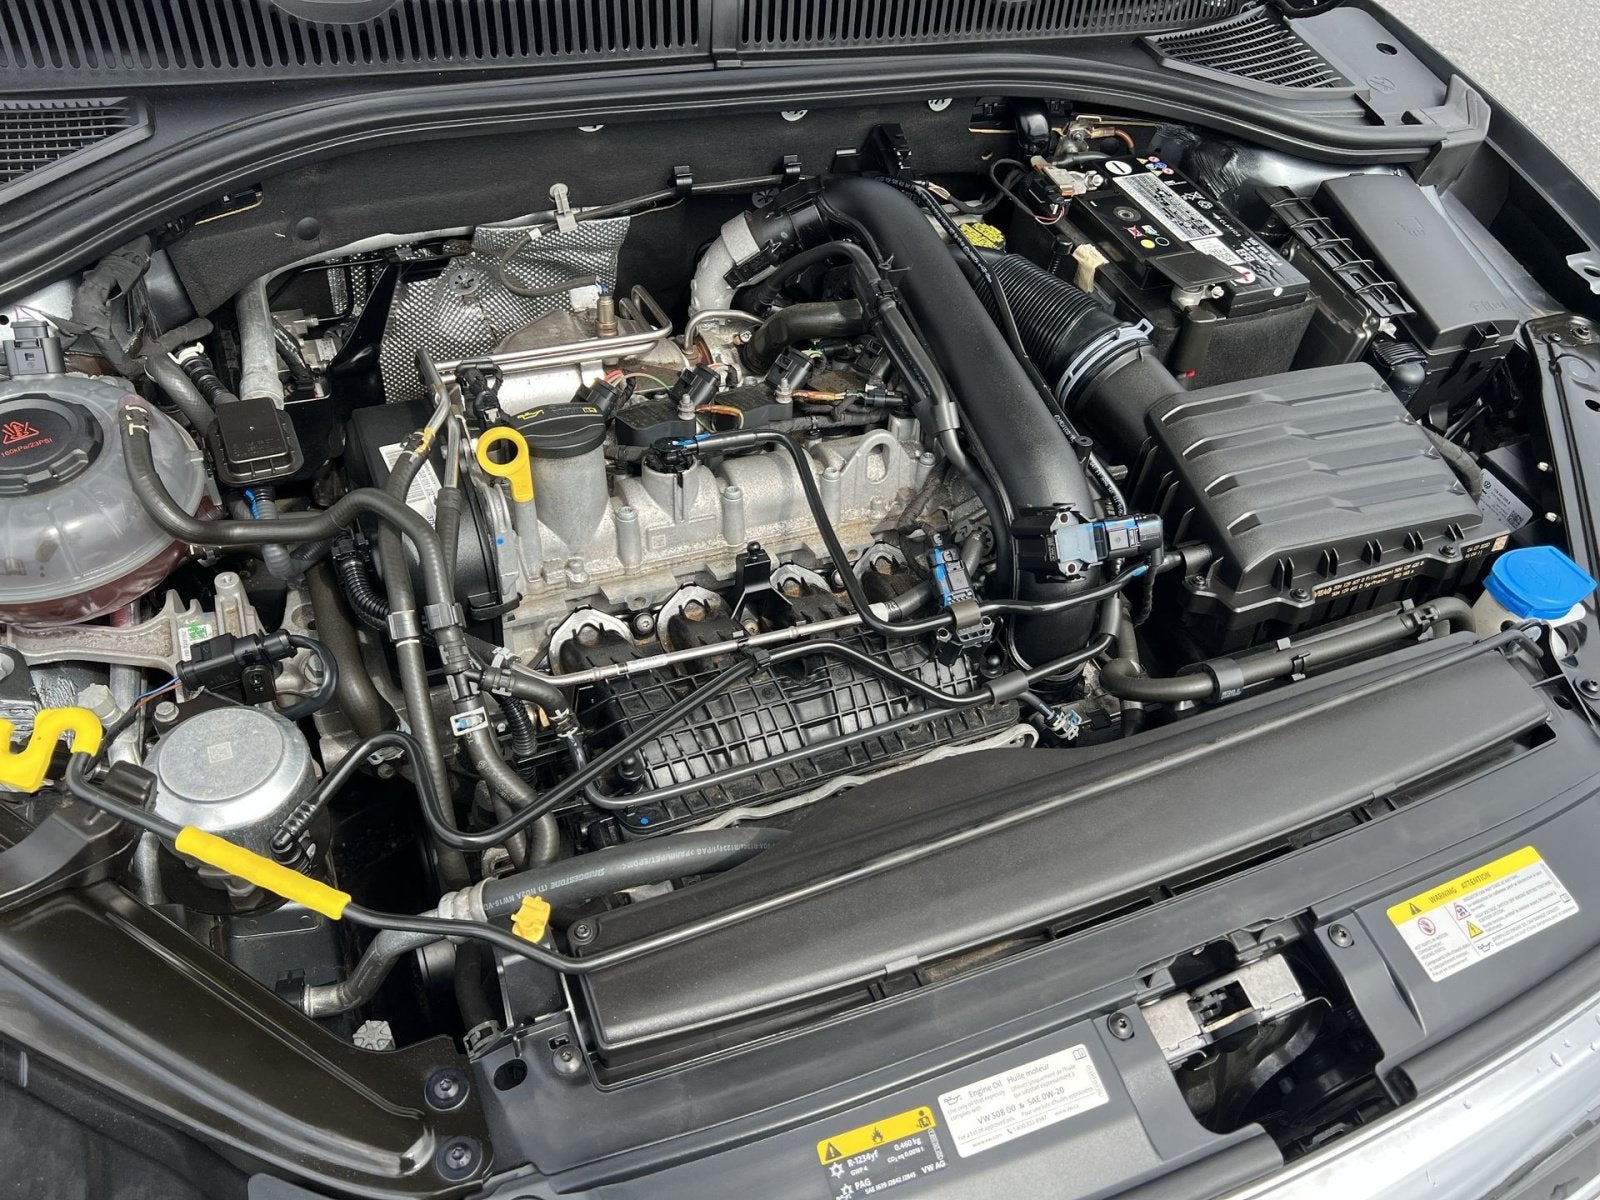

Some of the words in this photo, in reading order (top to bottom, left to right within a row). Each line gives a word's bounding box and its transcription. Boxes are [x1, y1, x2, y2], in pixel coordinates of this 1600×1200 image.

[1429, 887, 1457, 903] WARNING
[1461, 872, 1491, 889] ATTENTION
[1007, 1073, 1025, 1084] Huile
[1026, 1064, 1049, 1076] moteur
[968, 1086, 992, 1098] Engine
[992, 1080, 1002, 1089] Oil
[977, 1114, 990, 1124] VW
[992, 1109, 1005, 1119] 508
[1006, 1105, 1016, 1114] 00
[1027, 1096, 1041, 1105] SAE
[1042, 1087, 1064, 1100] 0W-20
[912, 1137, 922, 1146] kg
[847, 1150, 878, 1167] R-1234yf
[921, 1163, 934, 1174] VW
[935, 1160, 946, 1170] AG
[854, 1178, 872, 1190] PAG
[864, 1186, 875, 1194] SAE
